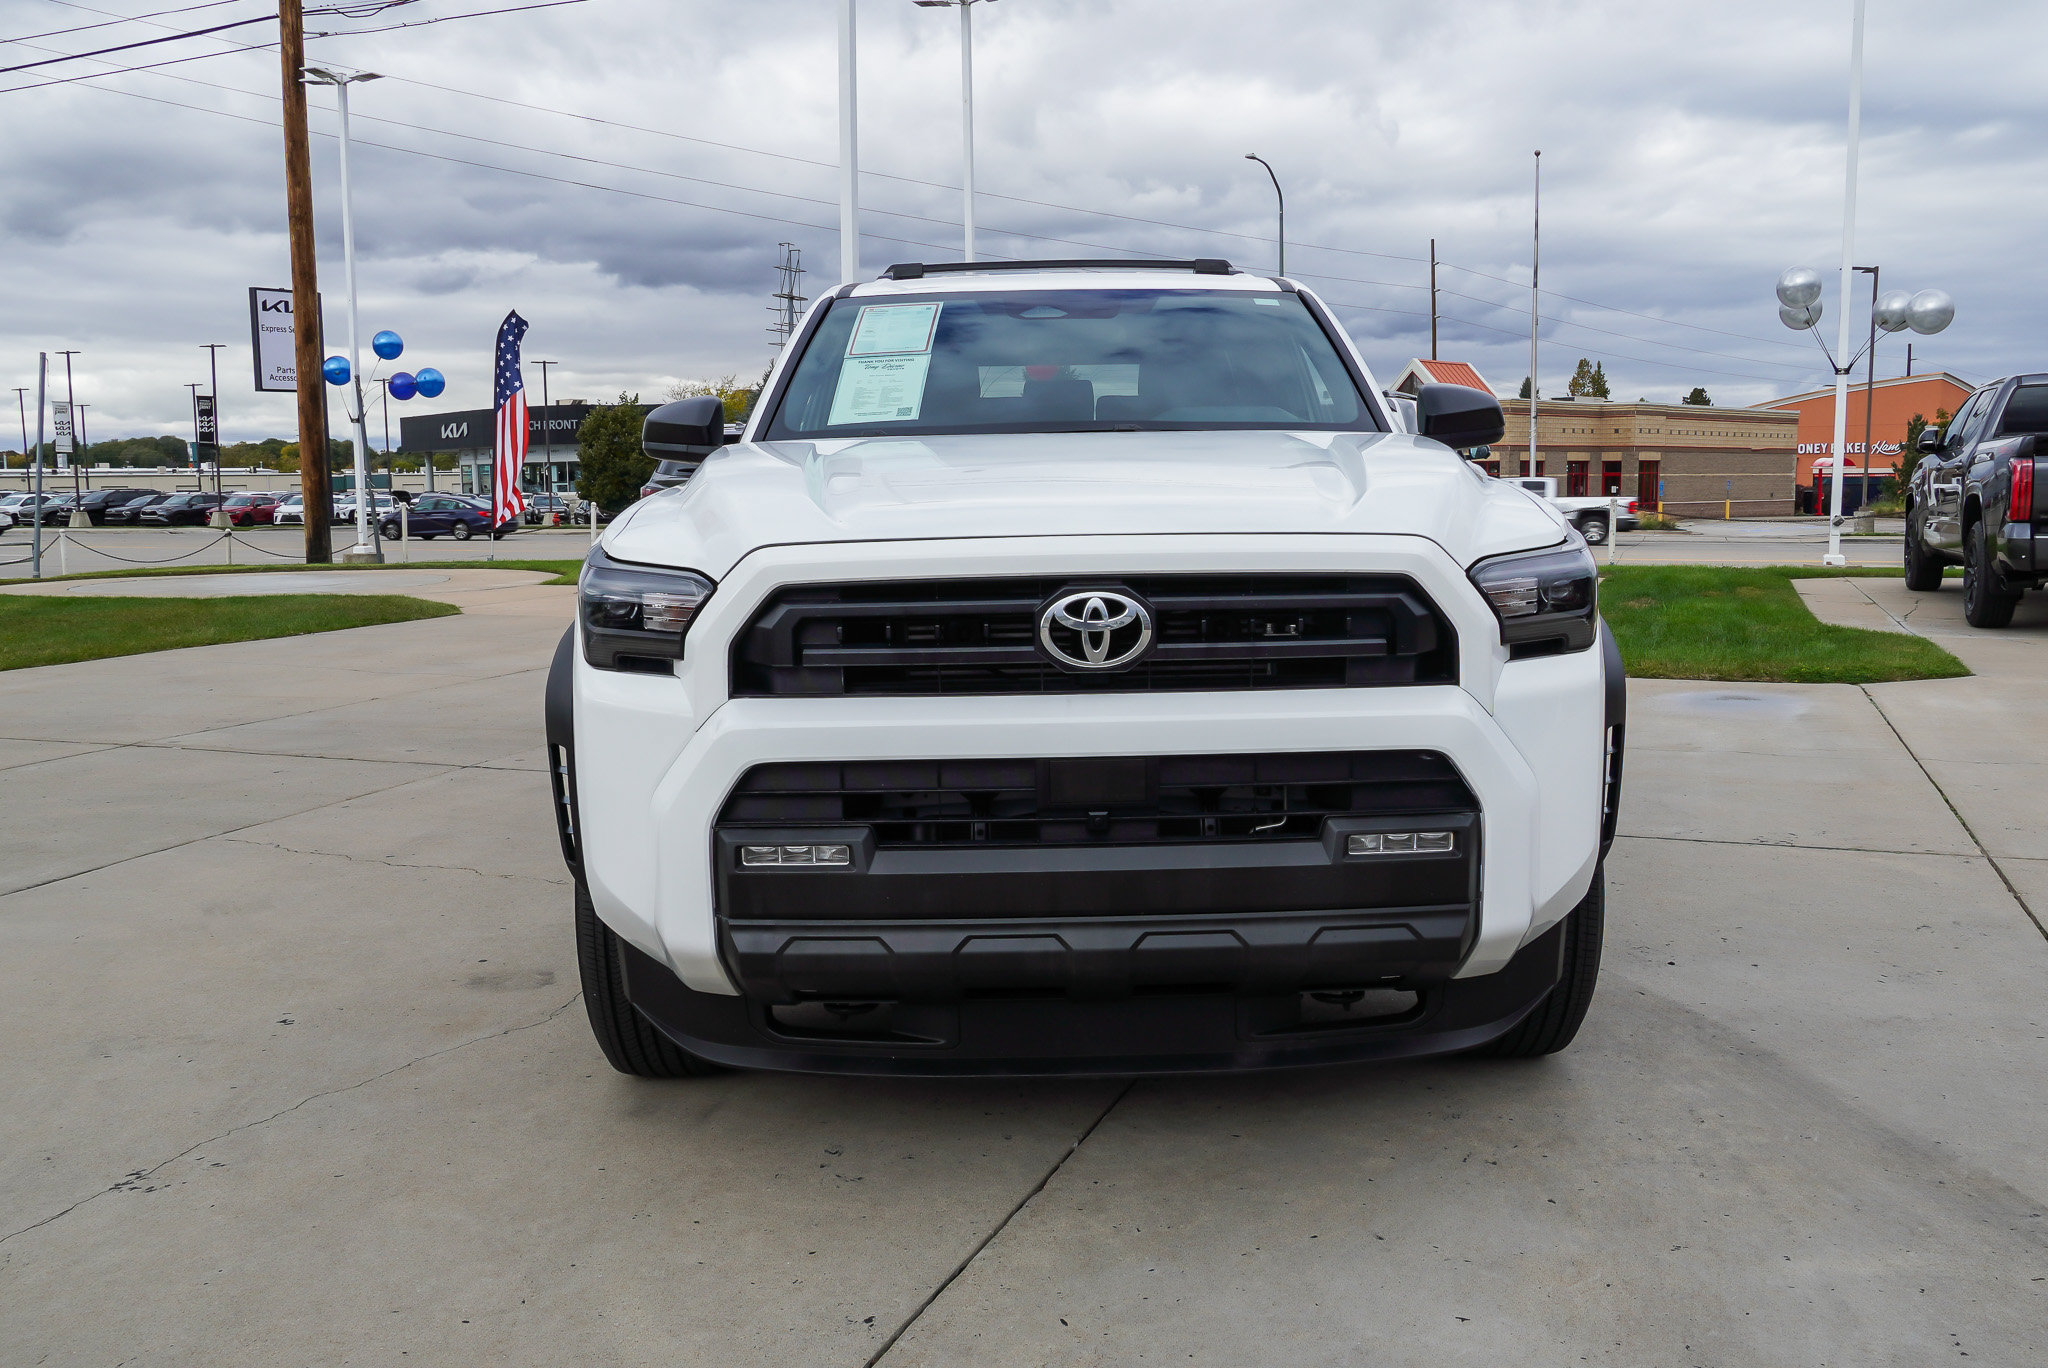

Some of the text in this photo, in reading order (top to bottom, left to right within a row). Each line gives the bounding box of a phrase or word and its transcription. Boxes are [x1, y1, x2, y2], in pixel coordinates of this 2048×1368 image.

[262, 299, 294, 313] KI
[261, 324, 287, 334] Express
[276, 366, 296, 374] Parts
[441, 422, 468, 439] KIA
[528, 420, 541, 431] CH
[1797, 440, 1901, 455] ONEY BKED Ham
